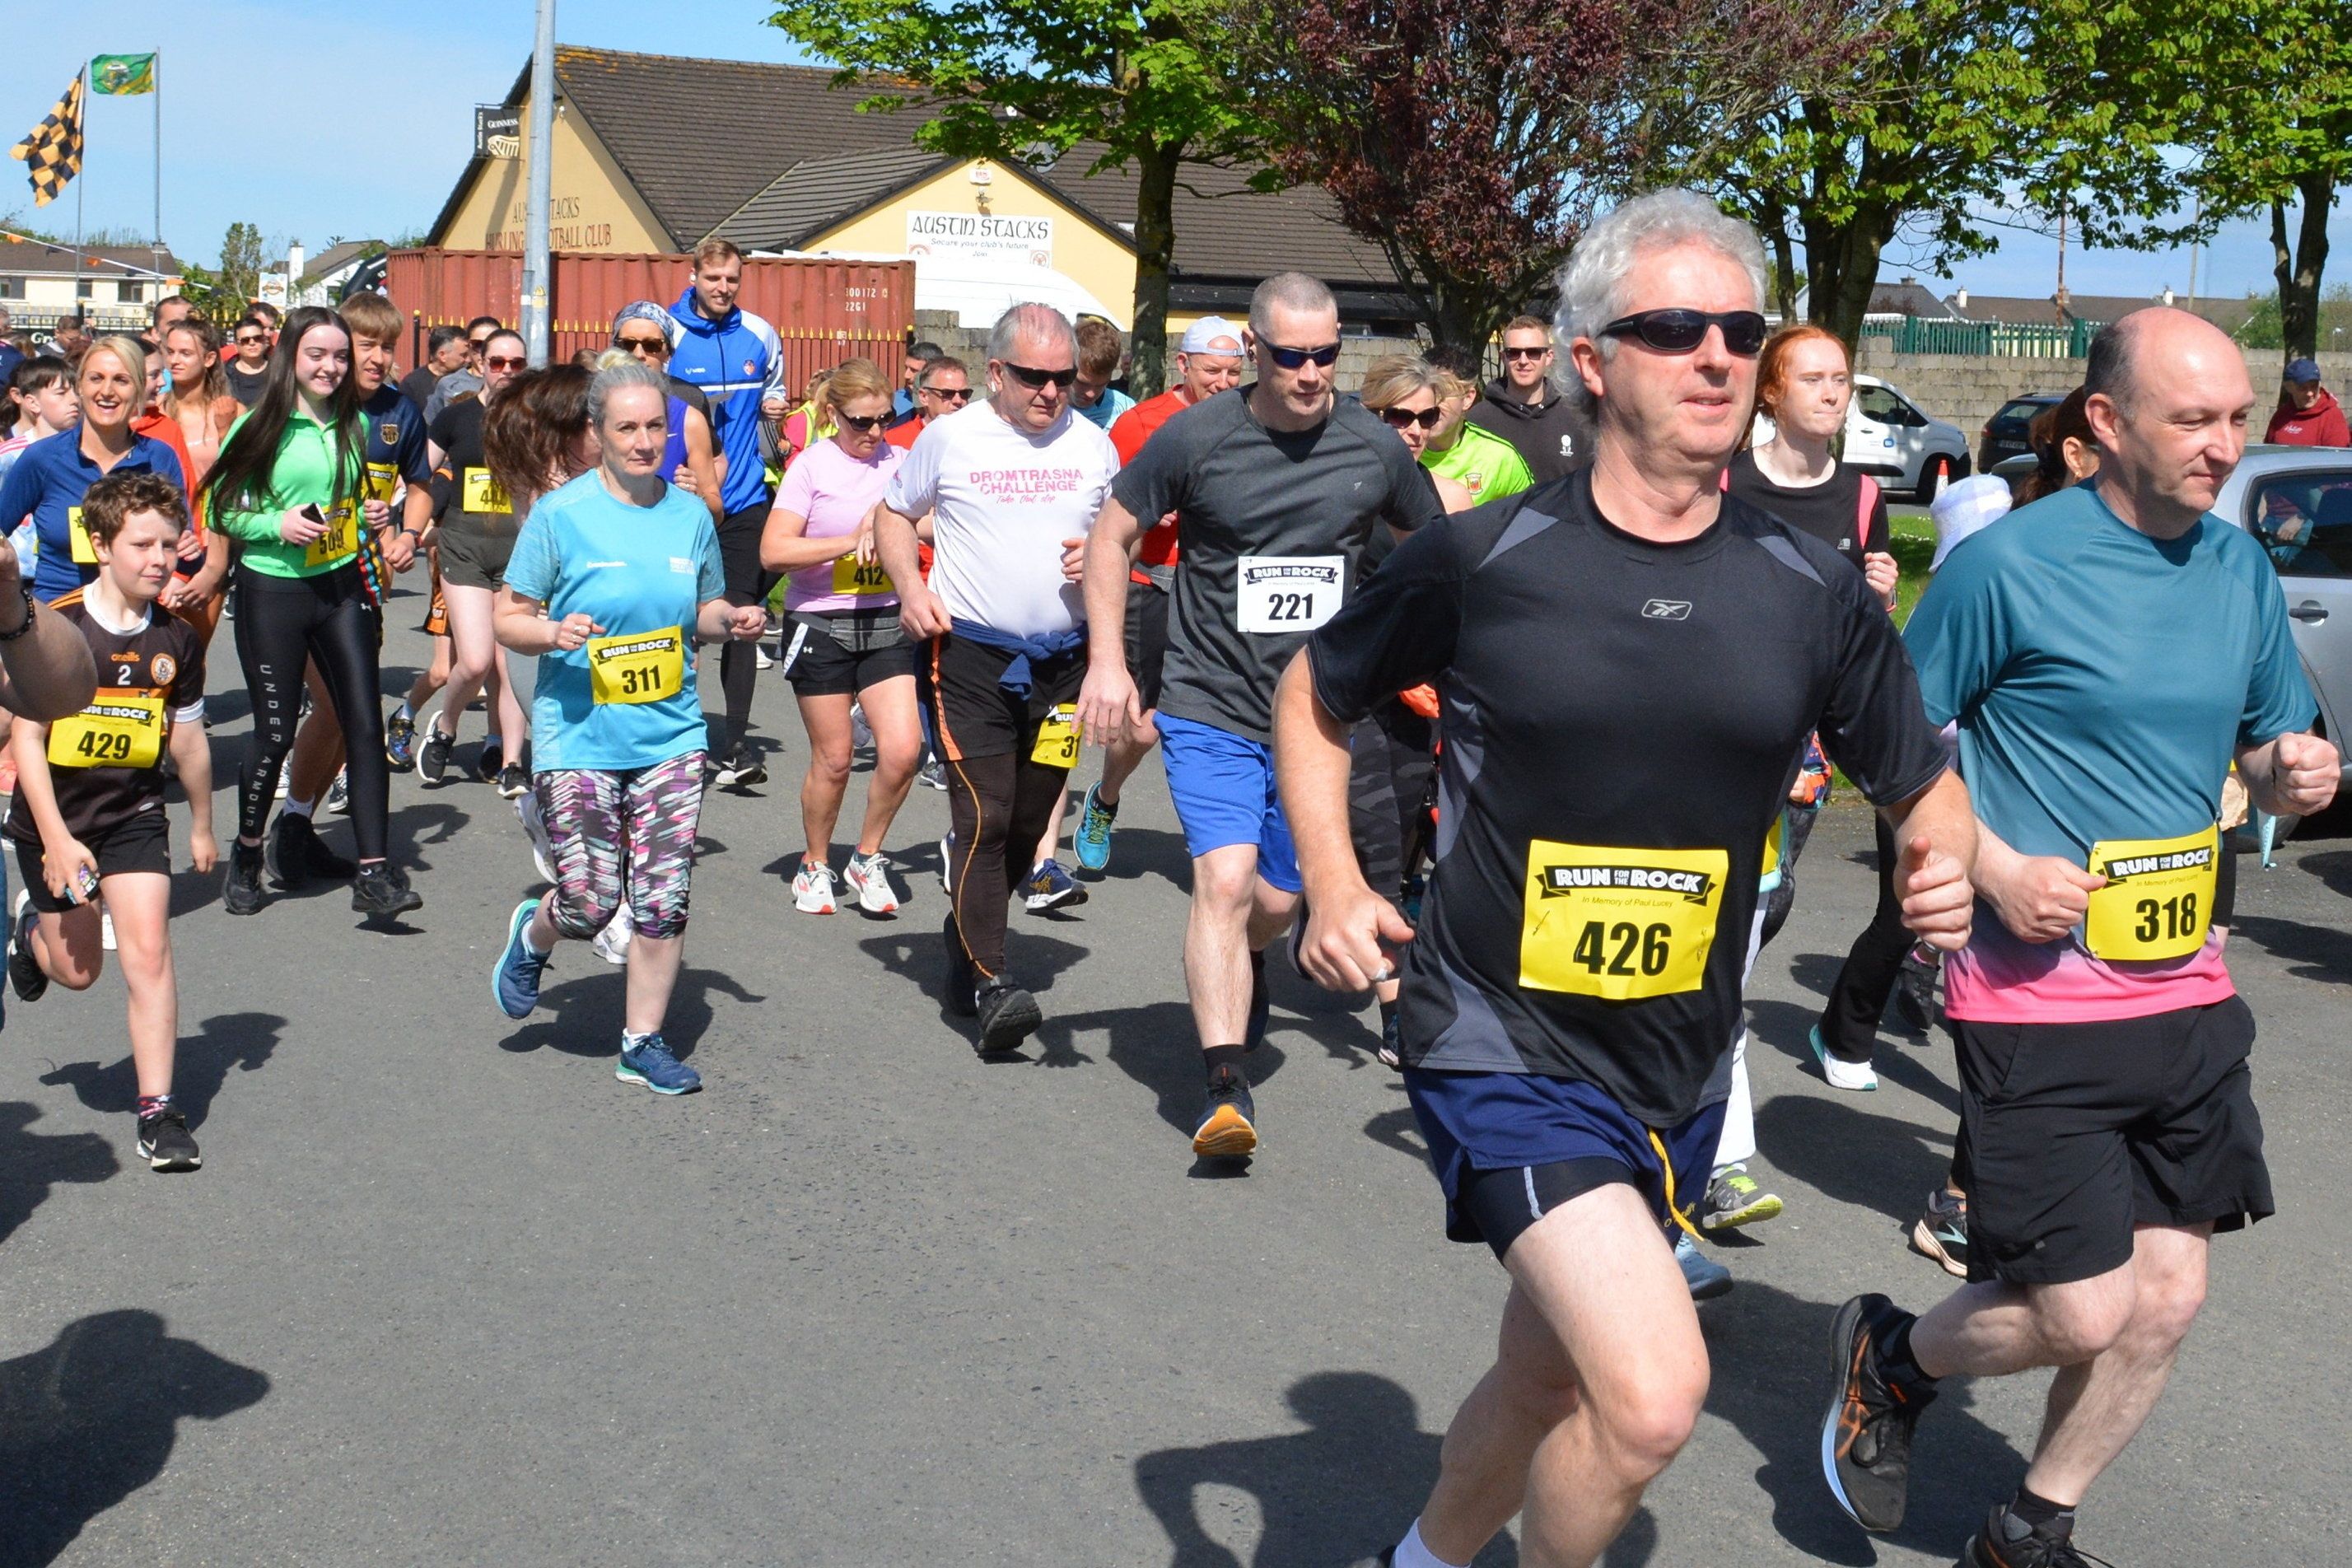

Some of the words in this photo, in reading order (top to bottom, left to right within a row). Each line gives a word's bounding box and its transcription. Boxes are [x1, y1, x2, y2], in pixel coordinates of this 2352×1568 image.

[488, 118, 519, 128] GUINNESS
[550, 197, 580, 220] TACKS
[586, 224, 611, 246] CLUB
[912, 216, 975, 236] AUSTIN
[981, 218, 1048, 240] STACKS
[931, 238, 959, 247] Secure
[30, 331, 54, 343] Gr
[970, 469, 1084, 484] DROMTRASNA
[980, 480, 1078, 495] CHALLENGE
[853, 566, 884, 586] 412
[1253, 567, 1282, 579] RUN
[1292, 567, 1332, 578] ROCK
[1268, 593, 1314, 620] 221
[601, 645, 630, 659] RUN
[637, 638, 671, 653] ROCK
[117, 665, 132, 686] 2
[622, 665, 661, 694] 311
[260, 664, 282, 743] UNDER
[110, 708, 148, 721] ROCK
[77, 730, 132, 760] 429
[245, 755, 273, 828] ARMOUR
[2112, 857, 2158, 876] RUN
[2172, 848, 2210, 868] ROCK
[1554, 869, 1611, 886] RUN
[1631, 870, 1703, 893] ROCK
[1614, 870, 1630, 878] FOR
[1614, 877, 1629, 885] THE
[1592, 897, 1623, 907] Memory
[1633, 898, 1651, 907] Paul
[2135, 893, 2197, 943] 318
[1573, 920, 1673, 977] 426
